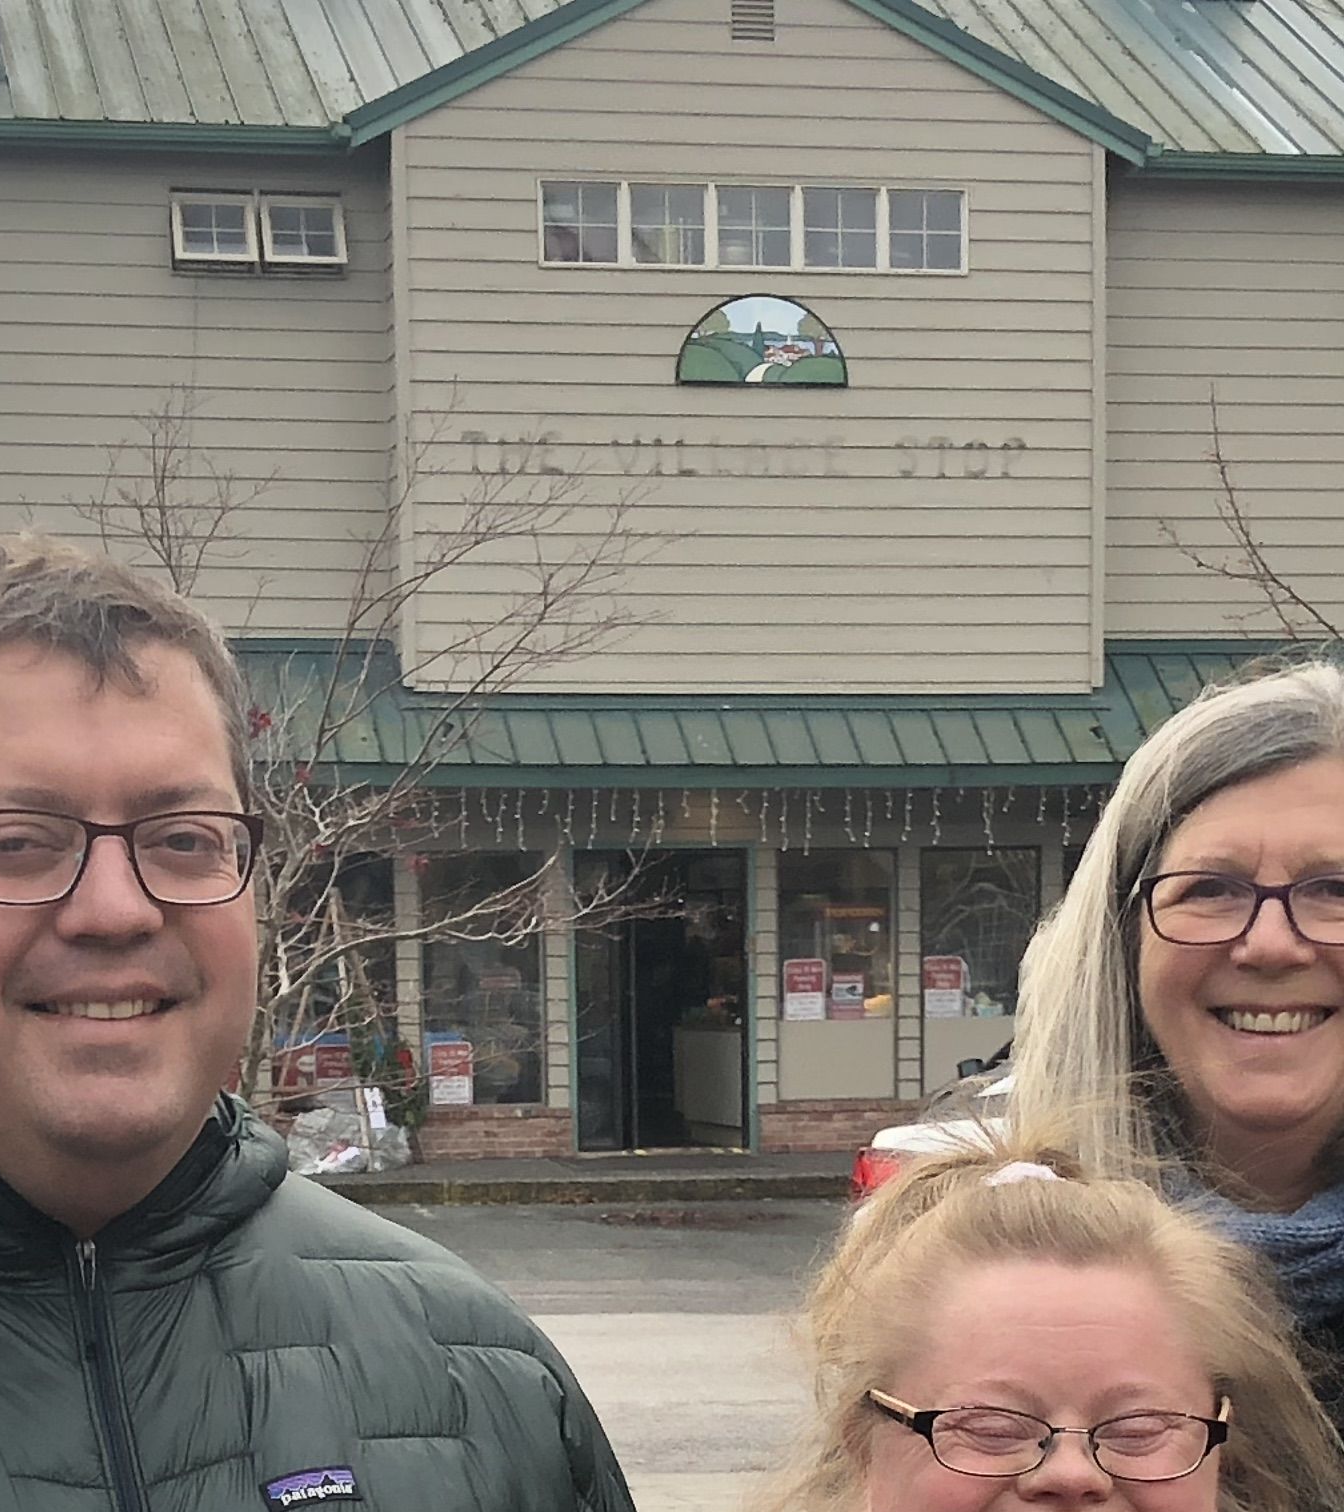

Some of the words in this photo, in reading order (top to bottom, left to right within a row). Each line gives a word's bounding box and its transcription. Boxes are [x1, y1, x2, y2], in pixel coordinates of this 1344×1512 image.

[460, 430, 564, 475] THE
[894, 436, 1027, 479] STOP
[280, 1484, 353, 1506] patagonia
